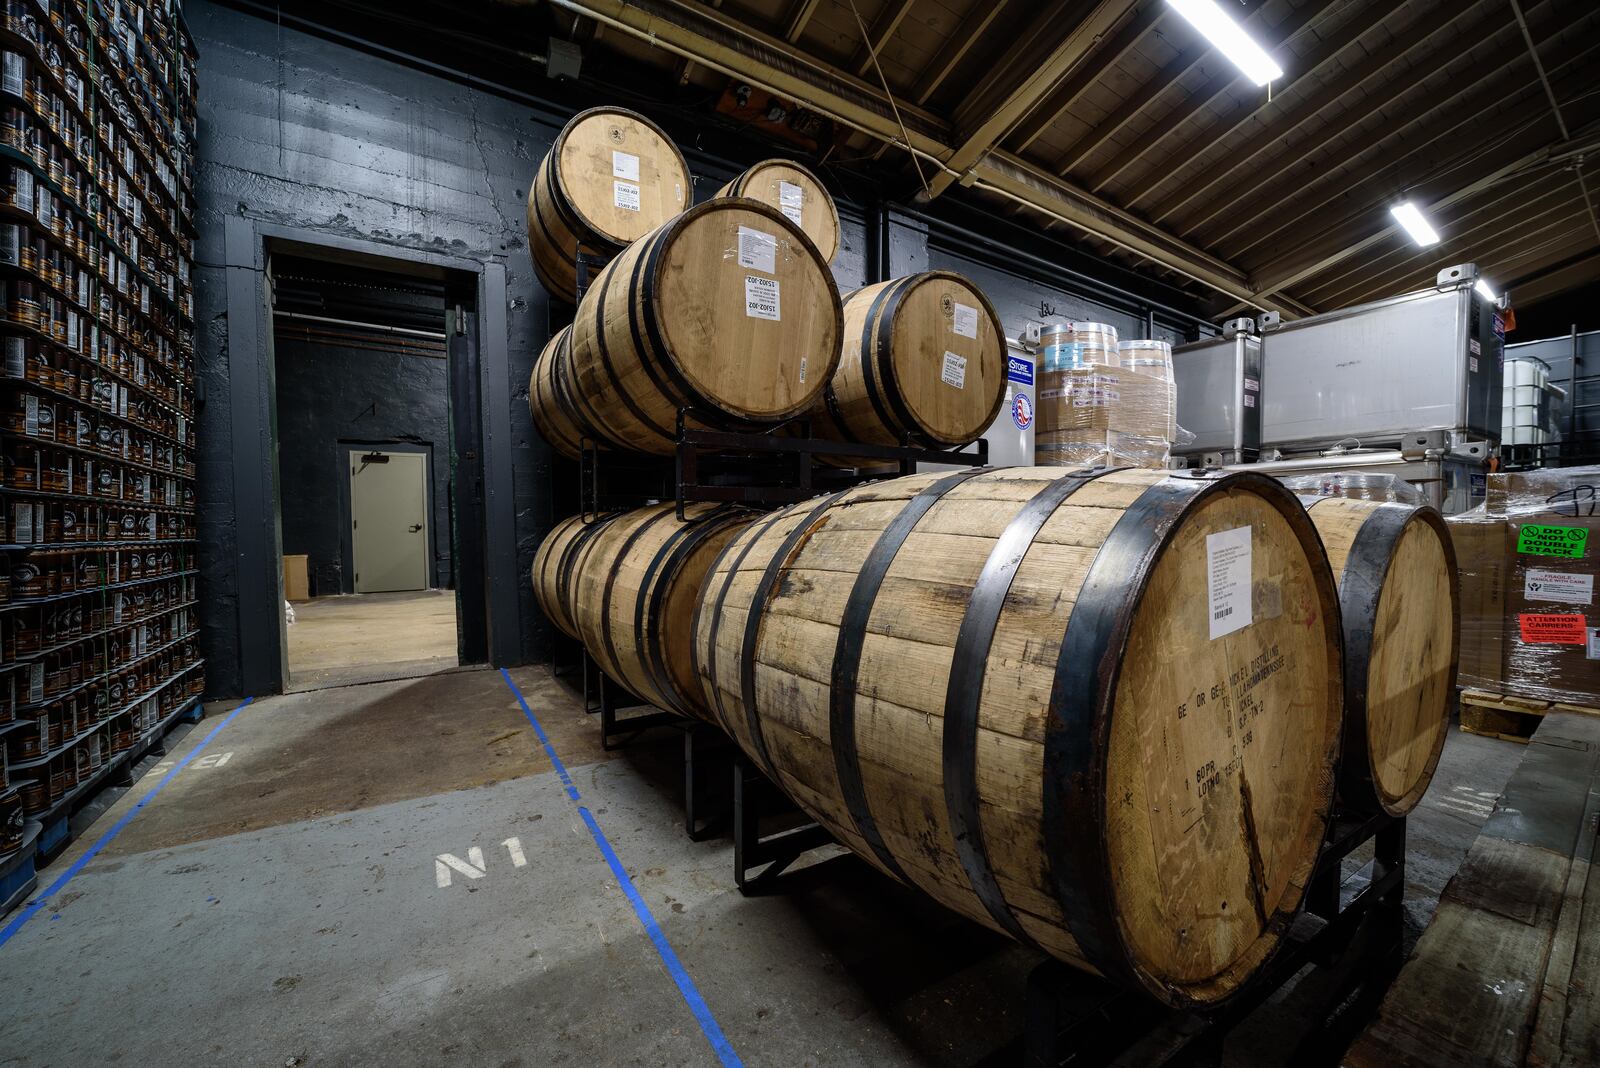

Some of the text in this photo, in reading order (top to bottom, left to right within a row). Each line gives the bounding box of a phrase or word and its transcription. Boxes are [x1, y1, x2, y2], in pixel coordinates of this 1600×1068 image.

[1537, 534, 1566, 542] NOT
[1523, 539, 1578, 549] DOUBLE
[1525, 546, 1573, 555] STACK
[435, 836, 528, 889] N1
